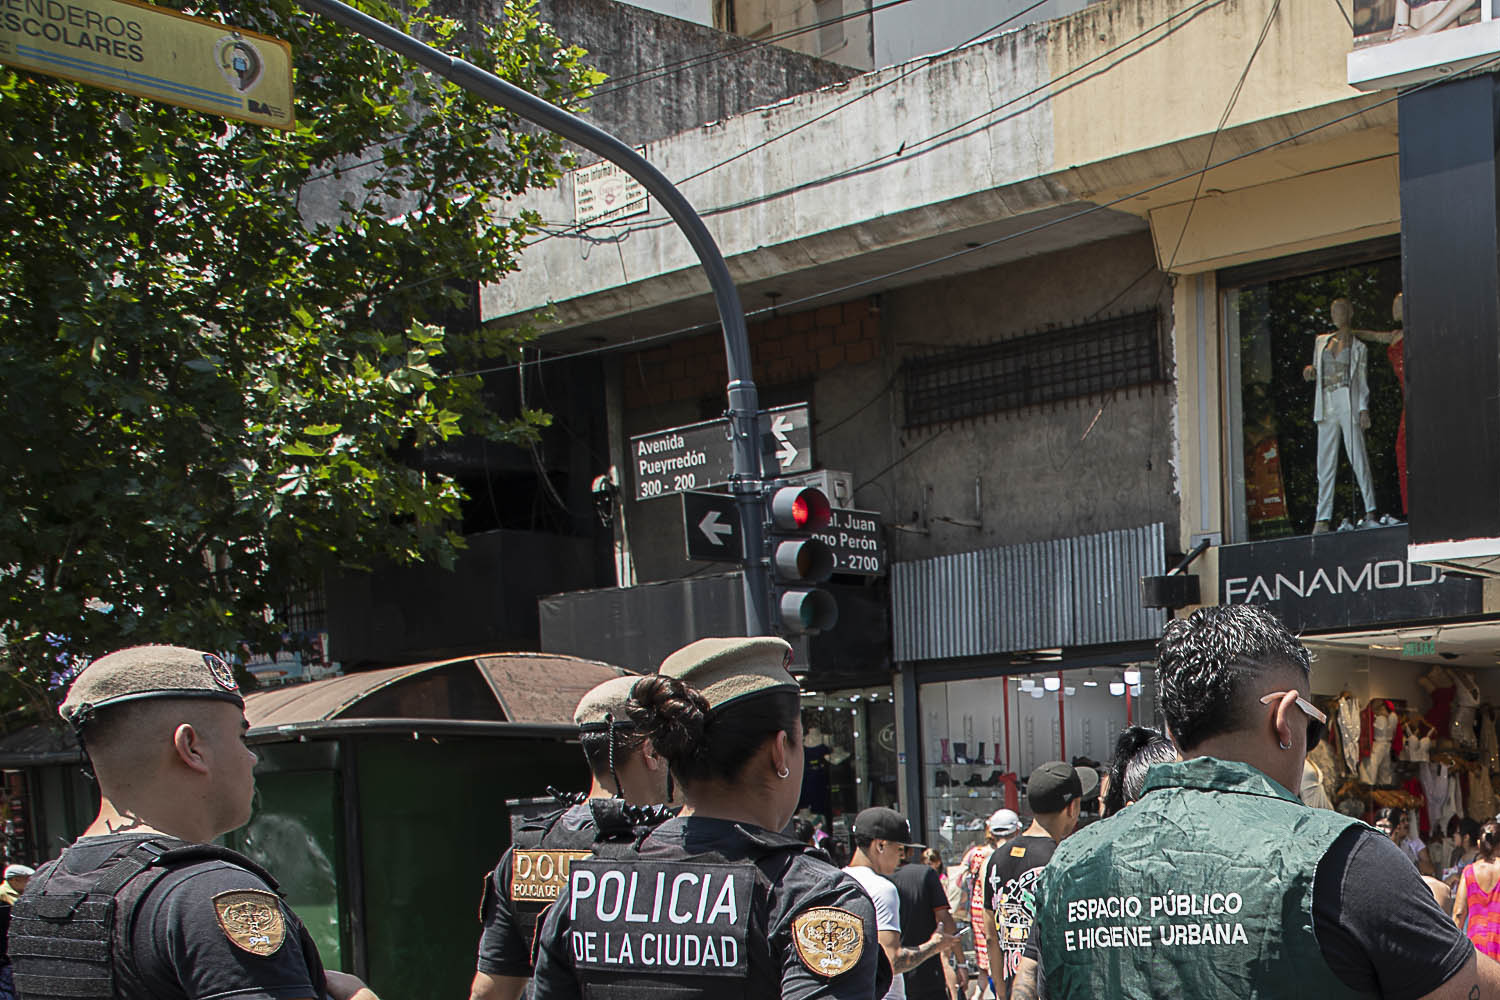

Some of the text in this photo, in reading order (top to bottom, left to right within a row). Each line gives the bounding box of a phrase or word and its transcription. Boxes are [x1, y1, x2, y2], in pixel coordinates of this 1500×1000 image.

[0, 0, 143, 42] ENDEROS
[637, 433, 685, 457] Avenida
[639, 449, 707, 476] Pueyrredón
[640, 480, 662, 498] 300
[674, 473, 696, 490] 200
[844, 513, 876, 532] Juan
[839, 532, 877, 551] Perón
[848, 554, 879, 571] 2700
[513, 883, 545, 897] POLICIA
[545, 885, 557, 897] DE
[570, 870, 738, 925] POLICIA
[1068, 890, 1243, 922] ESPACIO PÚBLICO
[572, 931, 739, 967] DE LA CIUDAD
[1064, 929, 1077, 952] E
[1159, 922, 1249, 946] URBANA
